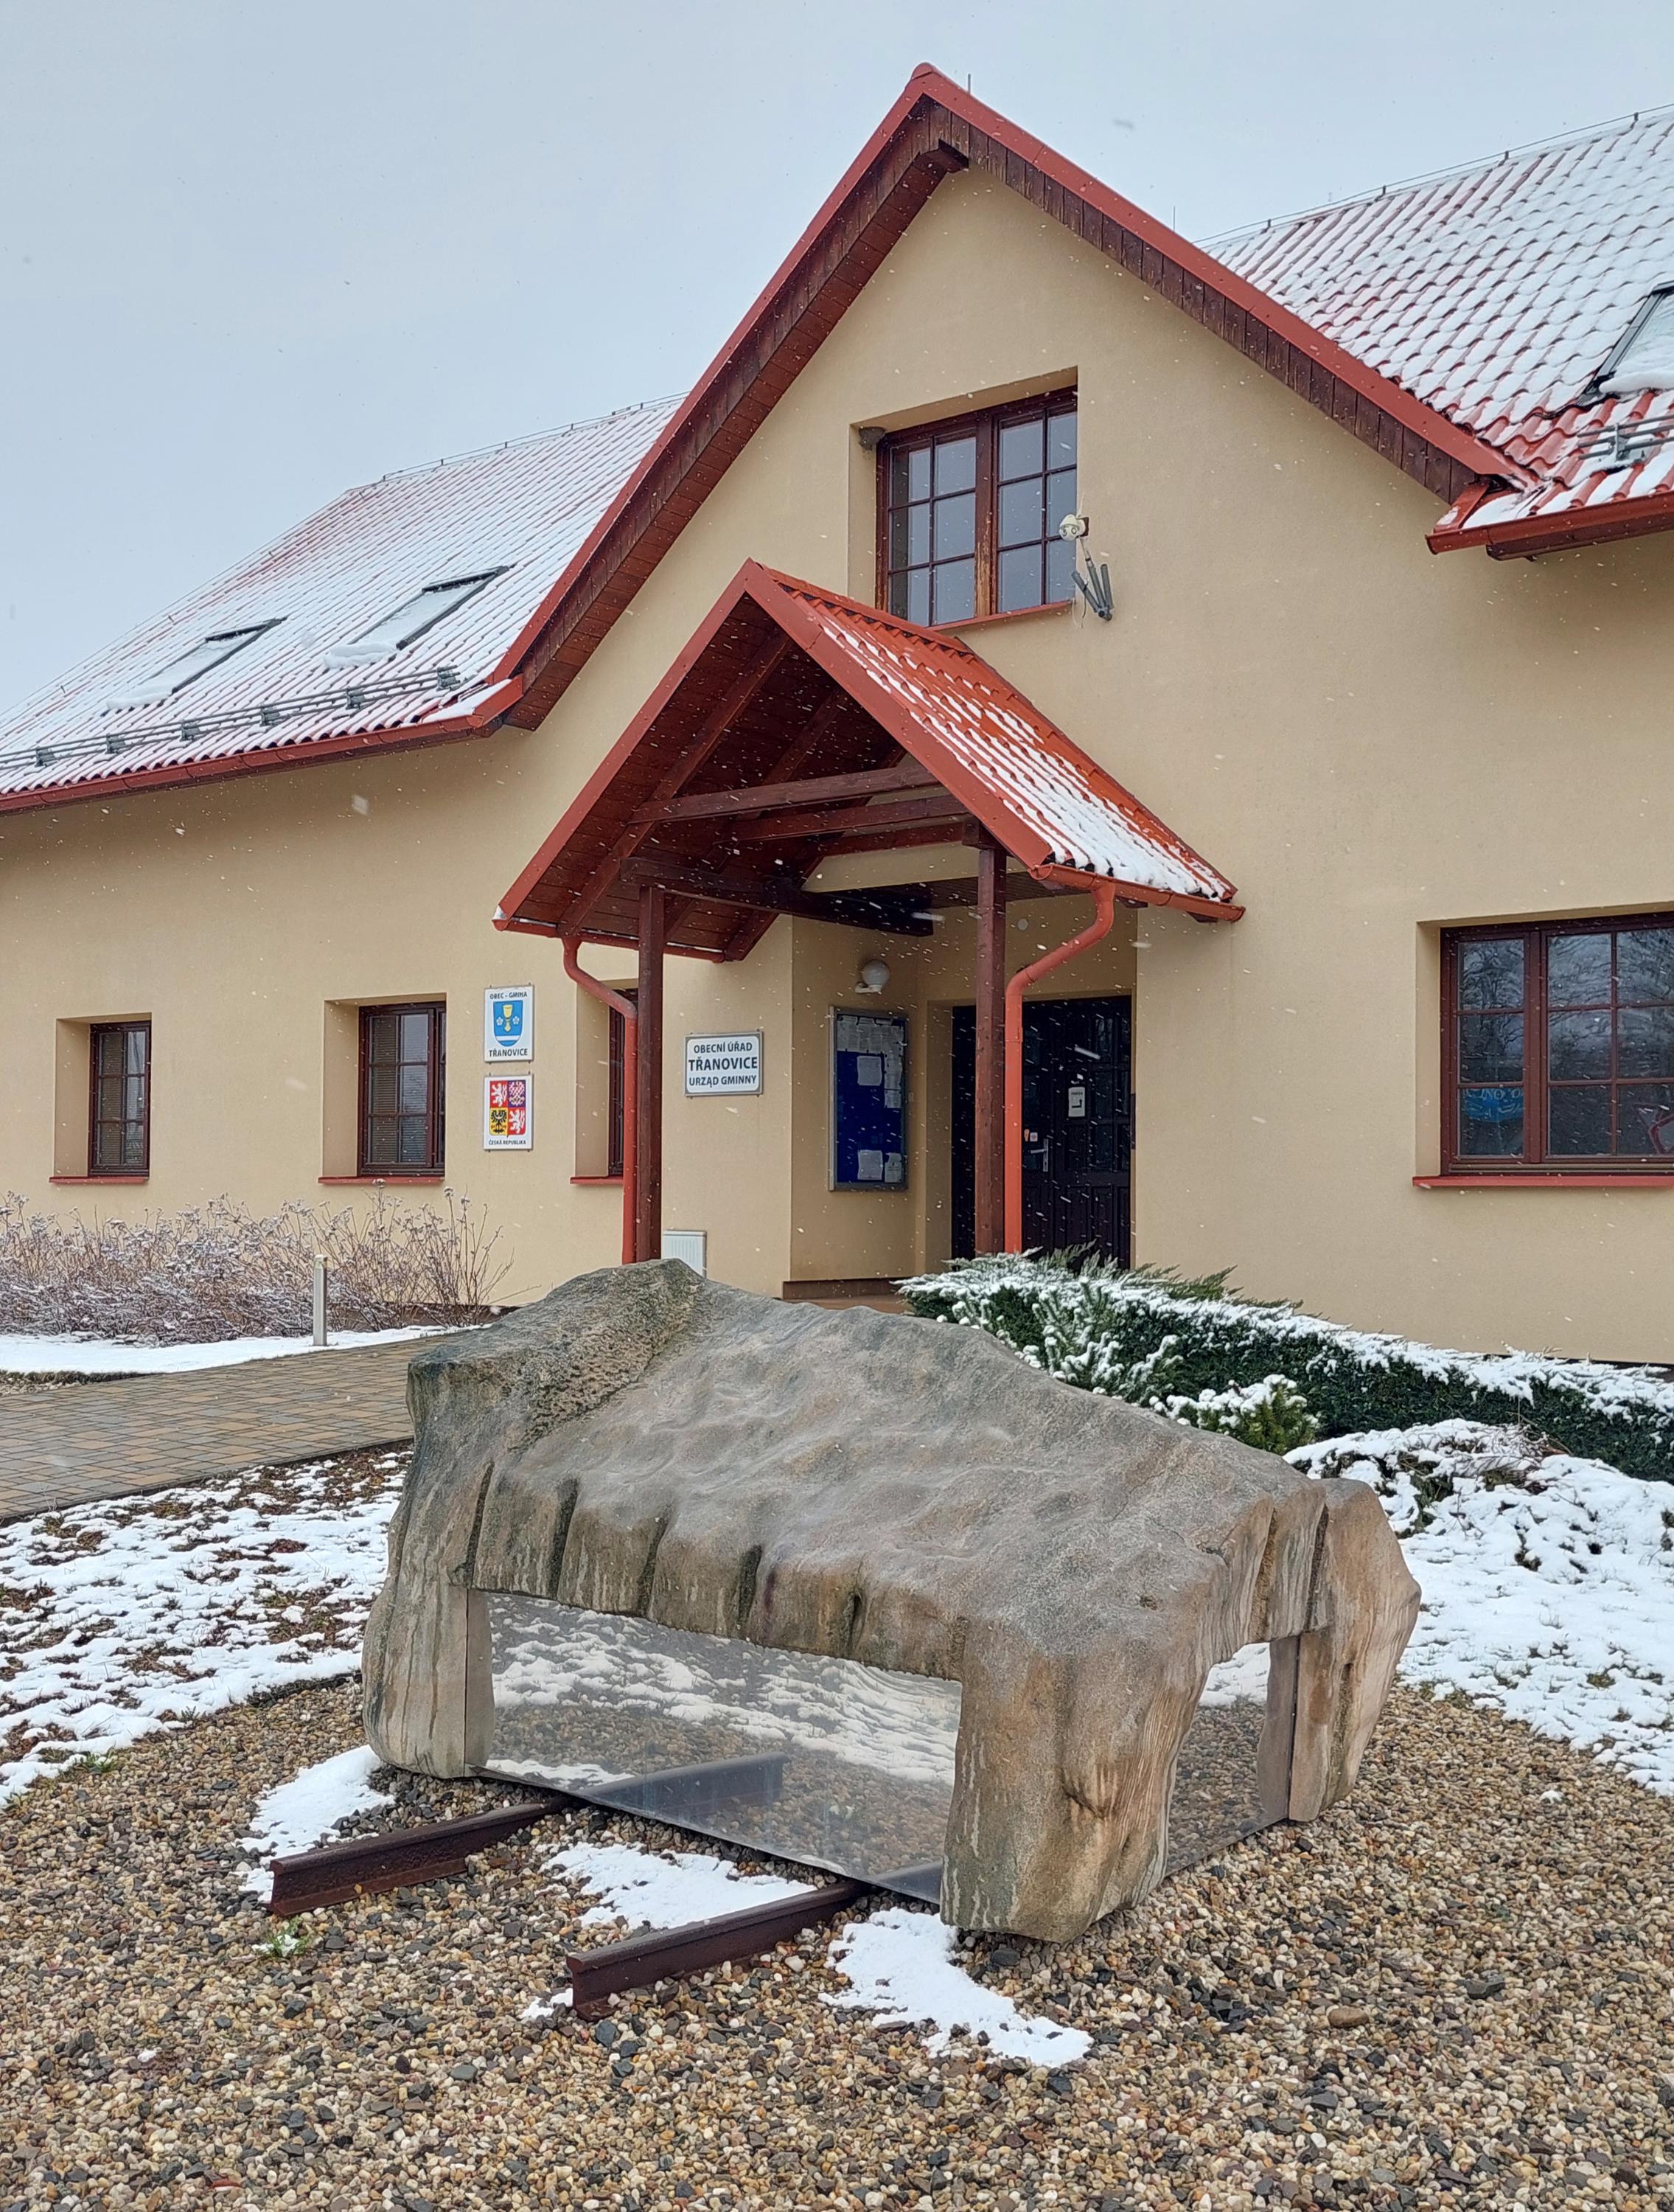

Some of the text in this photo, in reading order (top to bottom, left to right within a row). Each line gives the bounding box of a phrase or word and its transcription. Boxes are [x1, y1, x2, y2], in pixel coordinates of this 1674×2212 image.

[489, 1048, 529, 1057] TŘANOVICE
[694, 1040, 753, 1053] OBECNÍ ÚŘAD
[688, 1056, 758, 1071] TŘANOVICE
[689, 1075, 757, 1088] URZĄD GMINNY
